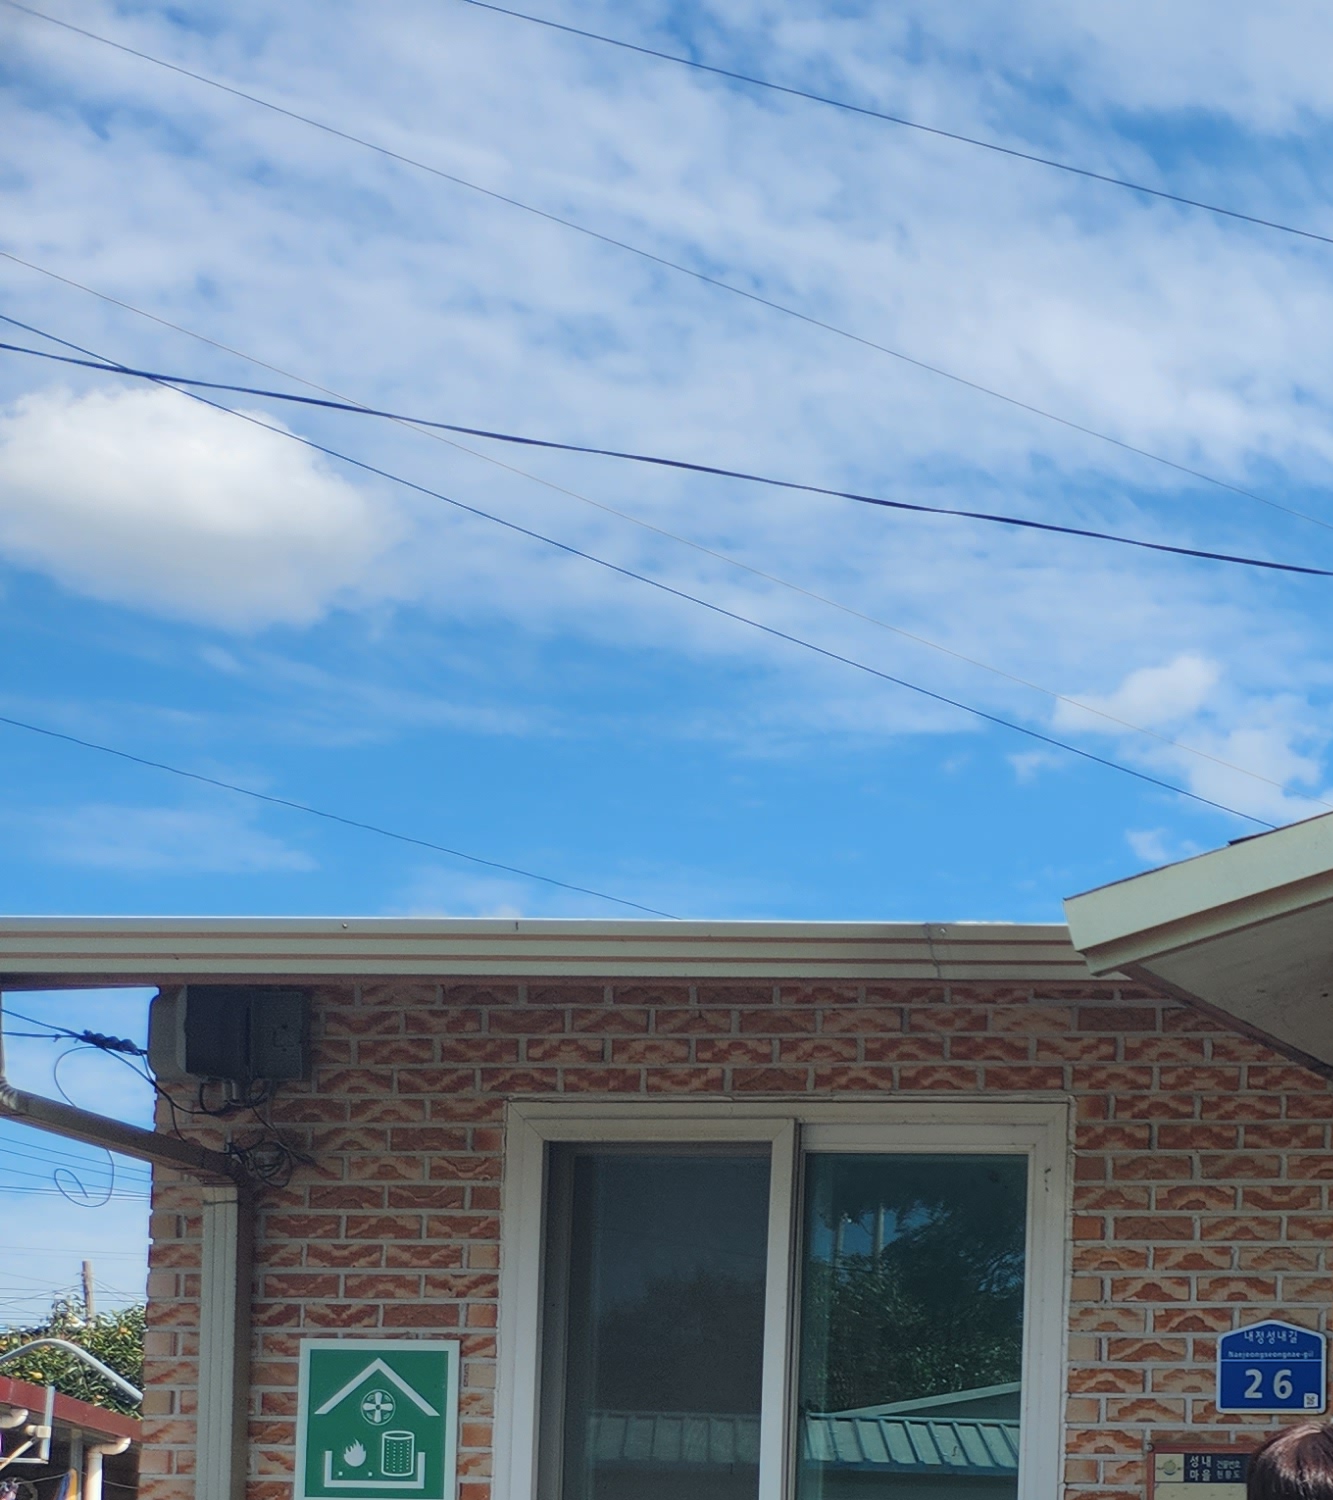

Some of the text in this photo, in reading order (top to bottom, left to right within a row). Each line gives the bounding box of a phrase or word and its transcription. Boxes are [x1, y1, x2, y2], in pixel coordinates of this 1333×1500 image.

[1243, 1330, 1298, 1345] 내정성내길
[1244, 1368, 1293, 1399] 26
[1189, 1469, 1212, 1482] 마을
